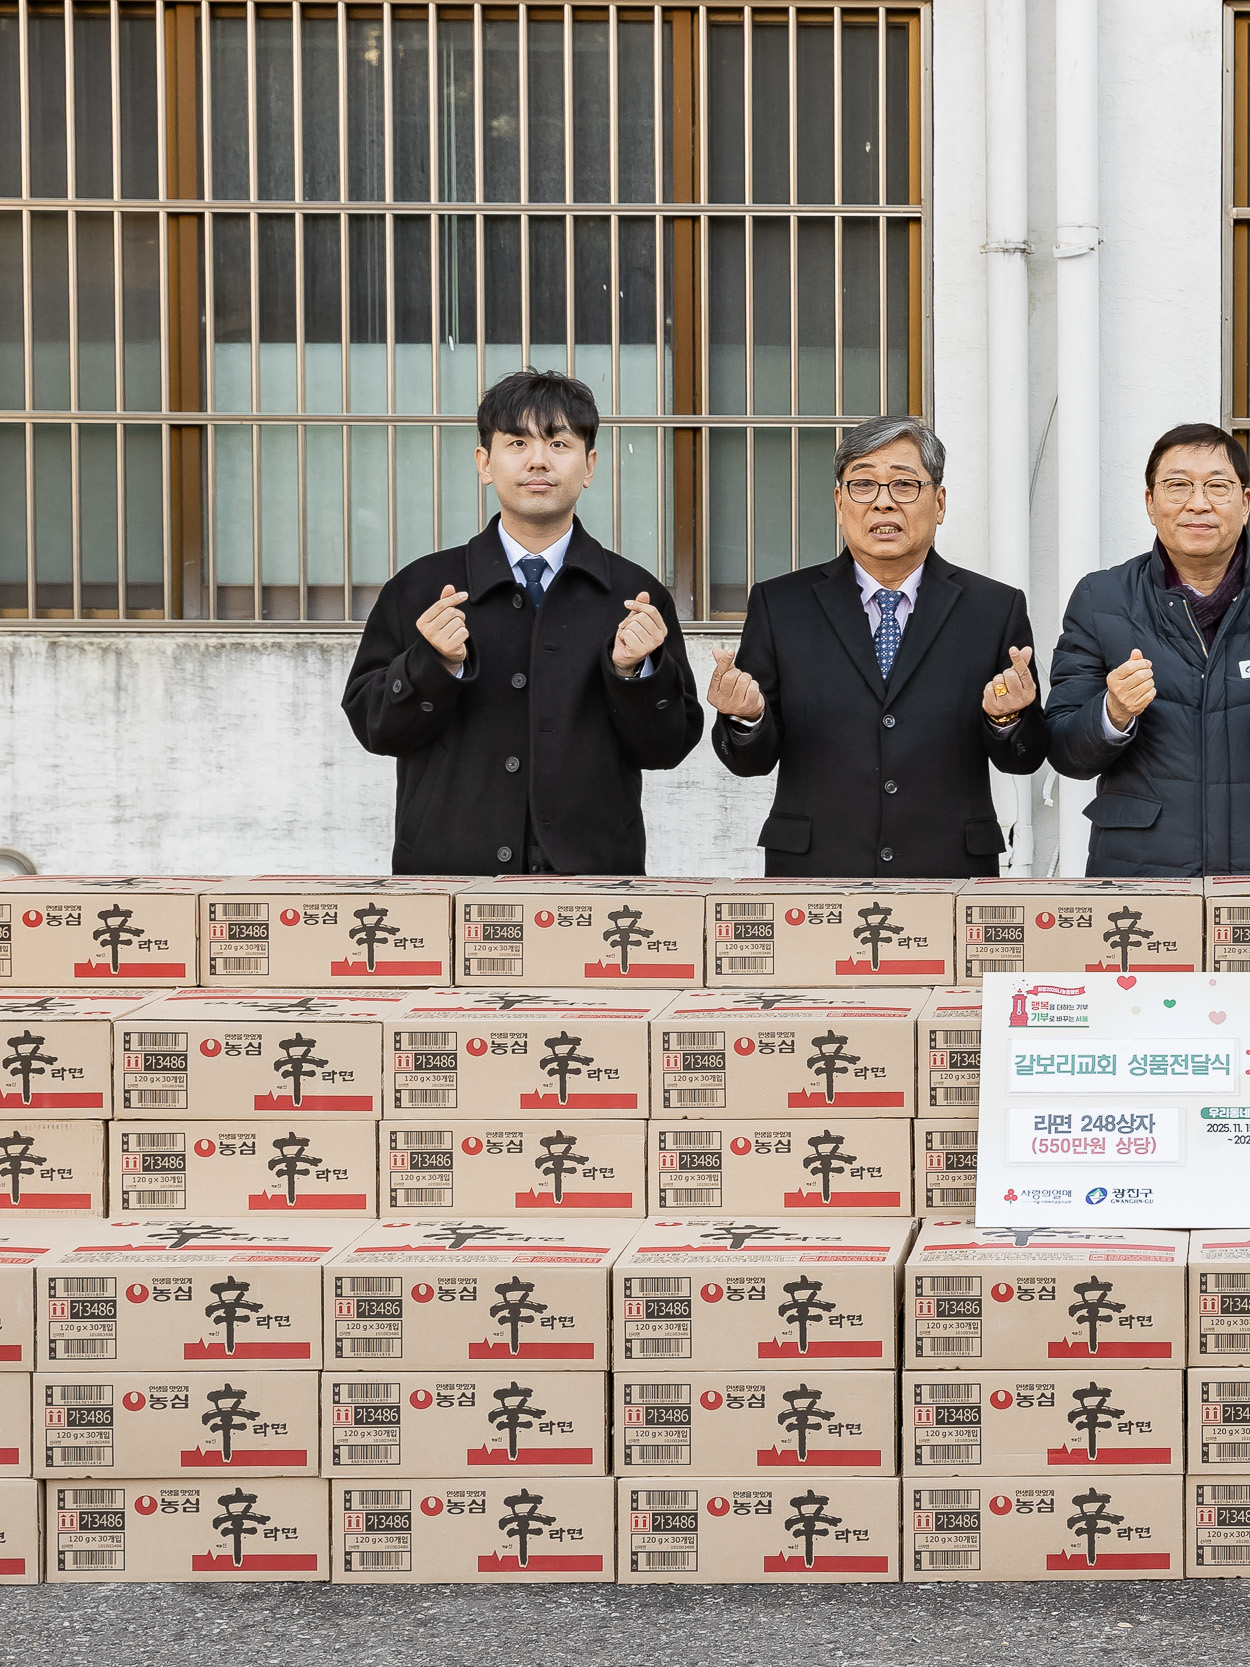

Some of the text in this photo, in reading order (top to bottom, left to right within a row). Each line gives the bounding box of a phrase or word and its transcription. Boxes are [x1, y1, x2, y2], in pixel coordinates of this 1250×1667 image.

[45, 913, 81, 927] 농심
[807, 911, 842, 925] 농심
[1057, 914, 1092, 929] 농심
[735, 924, 772, 938] 가3486
[393, 937, 425, 950] 라면
[1031, 1001, 1055, 1011] 행복을
[1031, 1012, 1055, 1022] 기부로
[244, 1033, 262, 1041] 맛있게
[490, 1040, 528, 1055] 농심
[758, 1040, 795, 1054] 농심
[416, 1054, 456, 1069] 가3486
[684, 1054, 724, 1069] 가3486
[951, 1053, 981, 1067] 가348
[1014, 1053, 1230, 1076] 갈보리교회 성품전달식
[50, 1066, 84, 1081] 라면
[1208, 1108, 1250, 1118] 우리동네
[1034, 1113, 1156, 1134] 라면 248상자
[486, 1139, 523, 1154] 농심
[754, 1140, 791, 1154] 농심
[1031, 1137, 1157, 1155] (550만원 상당)
[411, 1153, 451, 1168] 가3486
[680, 1154, 720, 1168] 가3486
[947, 1155, 978, 1168] 가348
[39, 1167, 73, 1181] 라면
[1020, 1189, 1072, 1200] 사랑의열매
[1111, 1188, 1153, 1198] 광진구
[437, 1277, 457, 1285] 인생을
[726, 1286, 765, 1301] 농심
[1016, 1286, 1056, 1301] 농심
[647, 1301, 690, 1317] 가3486
[938, 1300, 980, 1316] 가3486
[255, 1314, 291, 1330] 라면
[726, 1384, 745, 1392] 인생을
[149, 1394, 189, 1410] 농심
[1016, 1392, 1055, 1408] 농심
[69, 1410, 112, 1425] 가3486
[937, 1408, 979, 1423] 가3486
[538, 1420, 574, 1436] 라면
[1015, 1489, 1055, 1497] 인생을 맛있게
[160, 1498, 200, 1514] 농심
[446, 1499, 486, 1515] 농심
[81, 1513, 123, 1529] 가3486
[367, 1514, 410, 1530] 가3486
[834, 1528, 869, 1544] 라면
